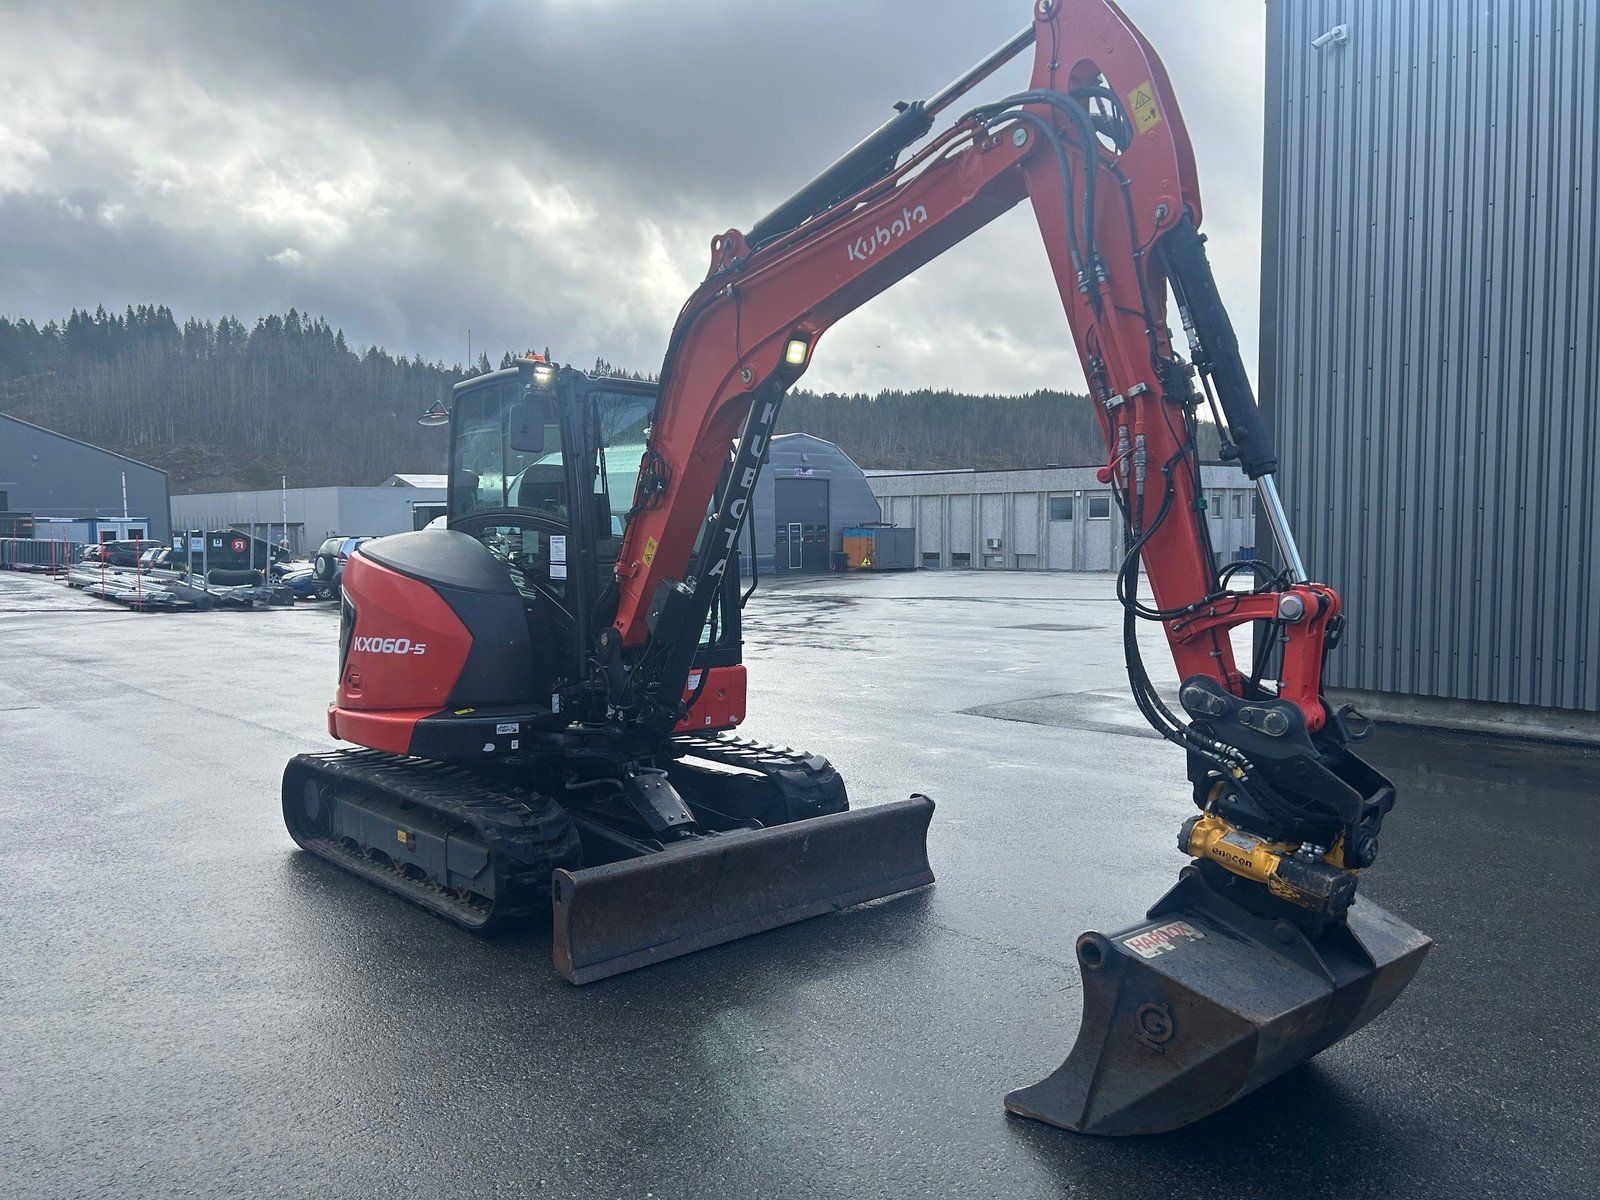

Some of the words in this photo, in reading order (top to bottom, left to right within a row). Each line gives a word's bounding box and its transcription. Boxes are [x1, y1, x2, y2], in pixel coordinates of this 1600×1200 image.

[847, 205, 928, 261] Kubota
[708, 402, 776, 577] KUBOTA
[354, 636, 426, 655] KX060-5
